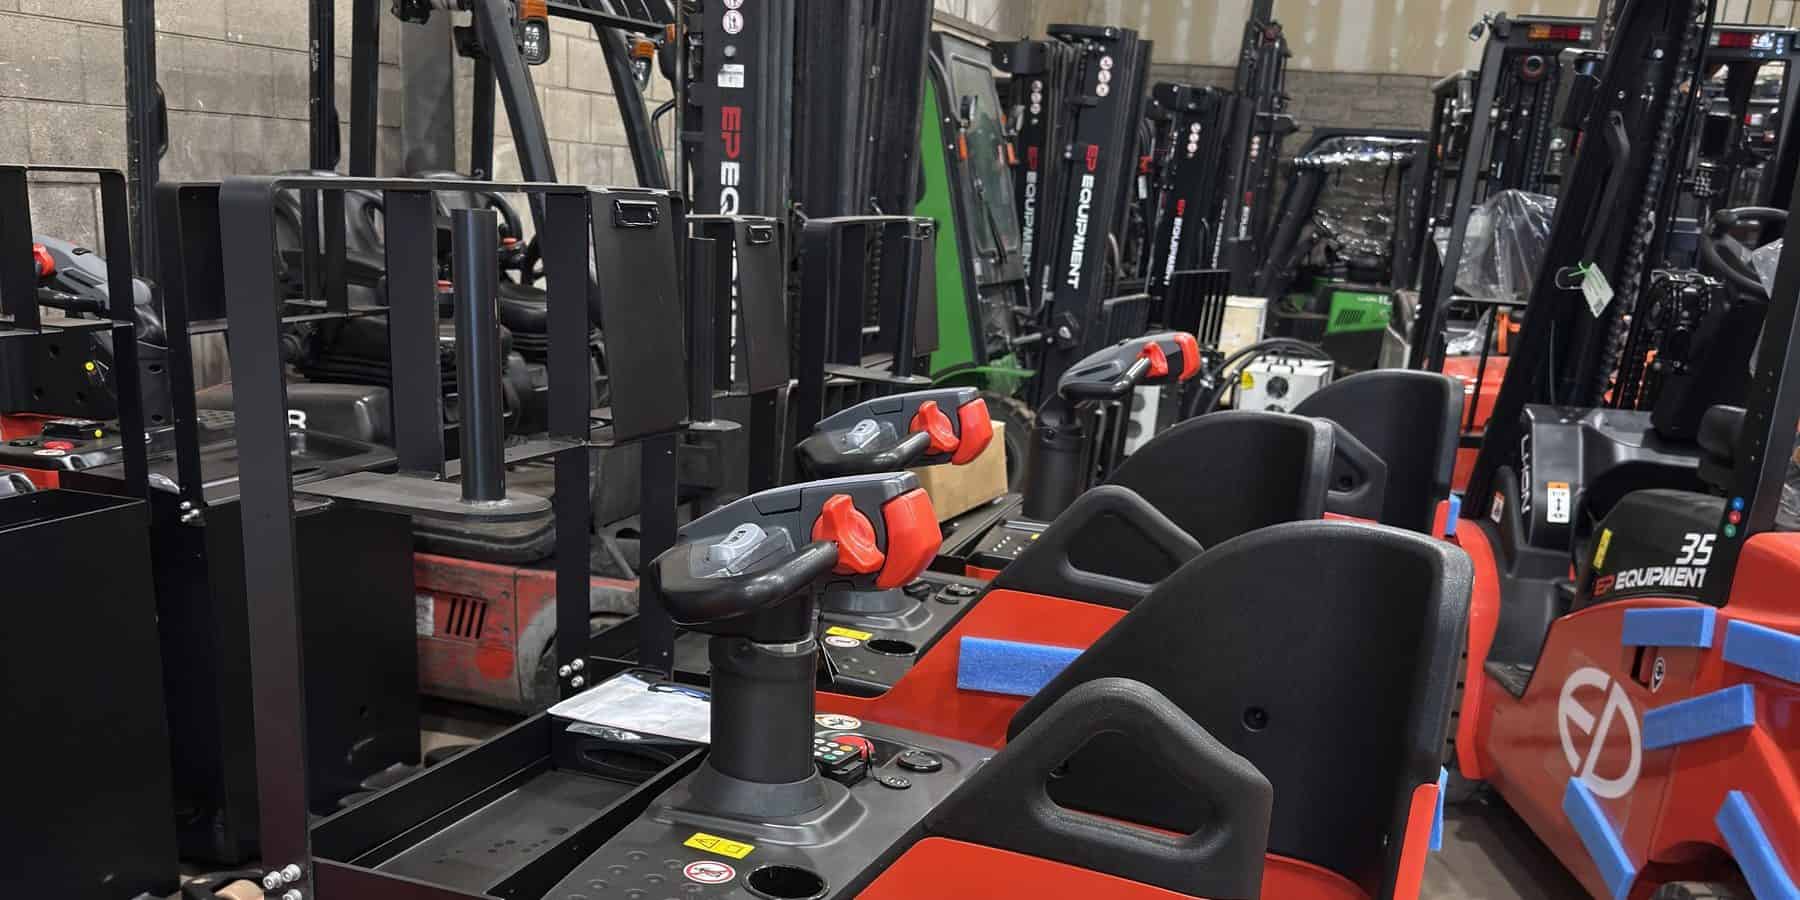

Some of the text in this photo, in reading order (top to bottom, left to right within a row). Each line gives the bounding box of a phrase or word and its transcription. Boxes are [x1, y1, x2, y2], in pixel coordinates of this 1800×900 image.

[721, 106, 742, 160] EP
[1022, 171, 1038, 278] EQUIPMENT
[1067, 144, 1099, 290] EP EQUIPMENT
[1675, 533, 1717, 566] 35
[1593, 567, 1707, 597] EP EQUIPMENT
